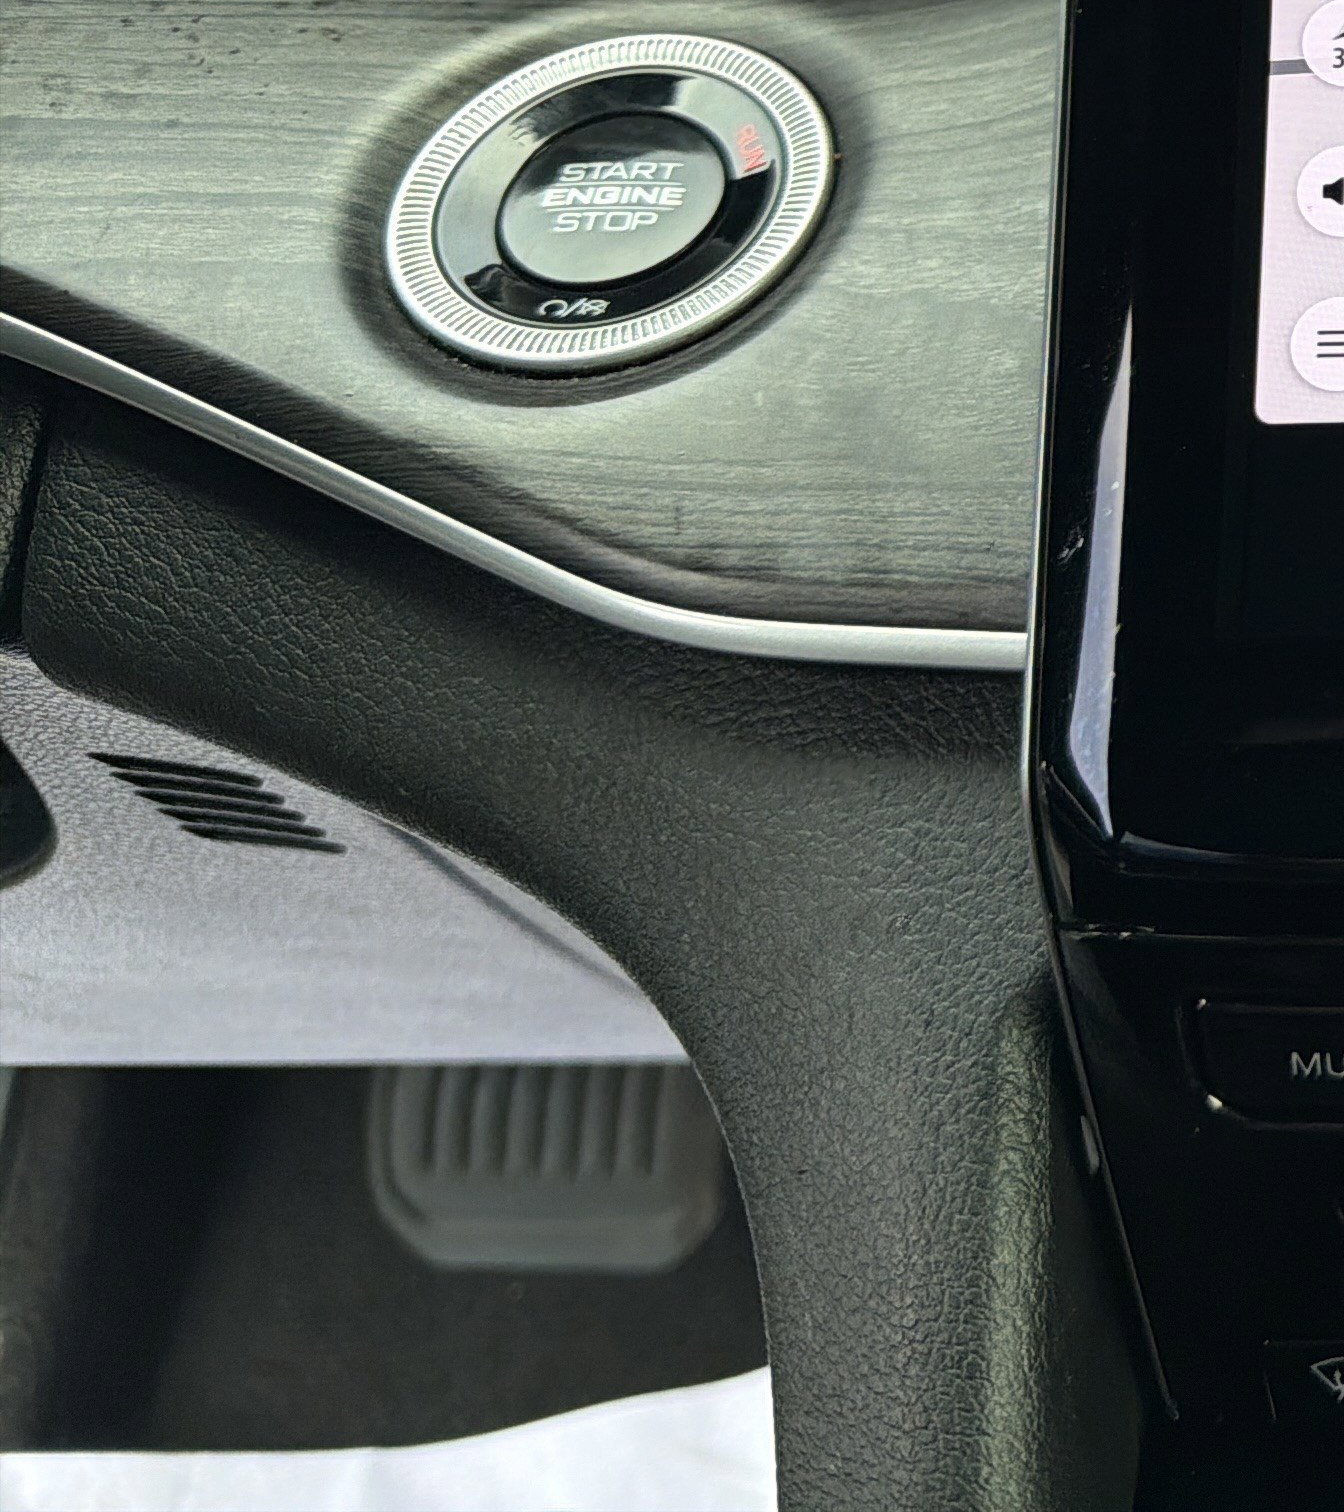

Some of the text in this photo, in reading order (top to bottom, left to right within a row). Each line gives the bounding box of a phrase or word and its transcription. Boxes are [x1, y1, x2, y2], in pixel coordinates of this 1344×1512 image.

[558, 162, 685, 182] START
[541, 187, 687, 208] ENGINE
[553, 212, 658, 233] STOP
